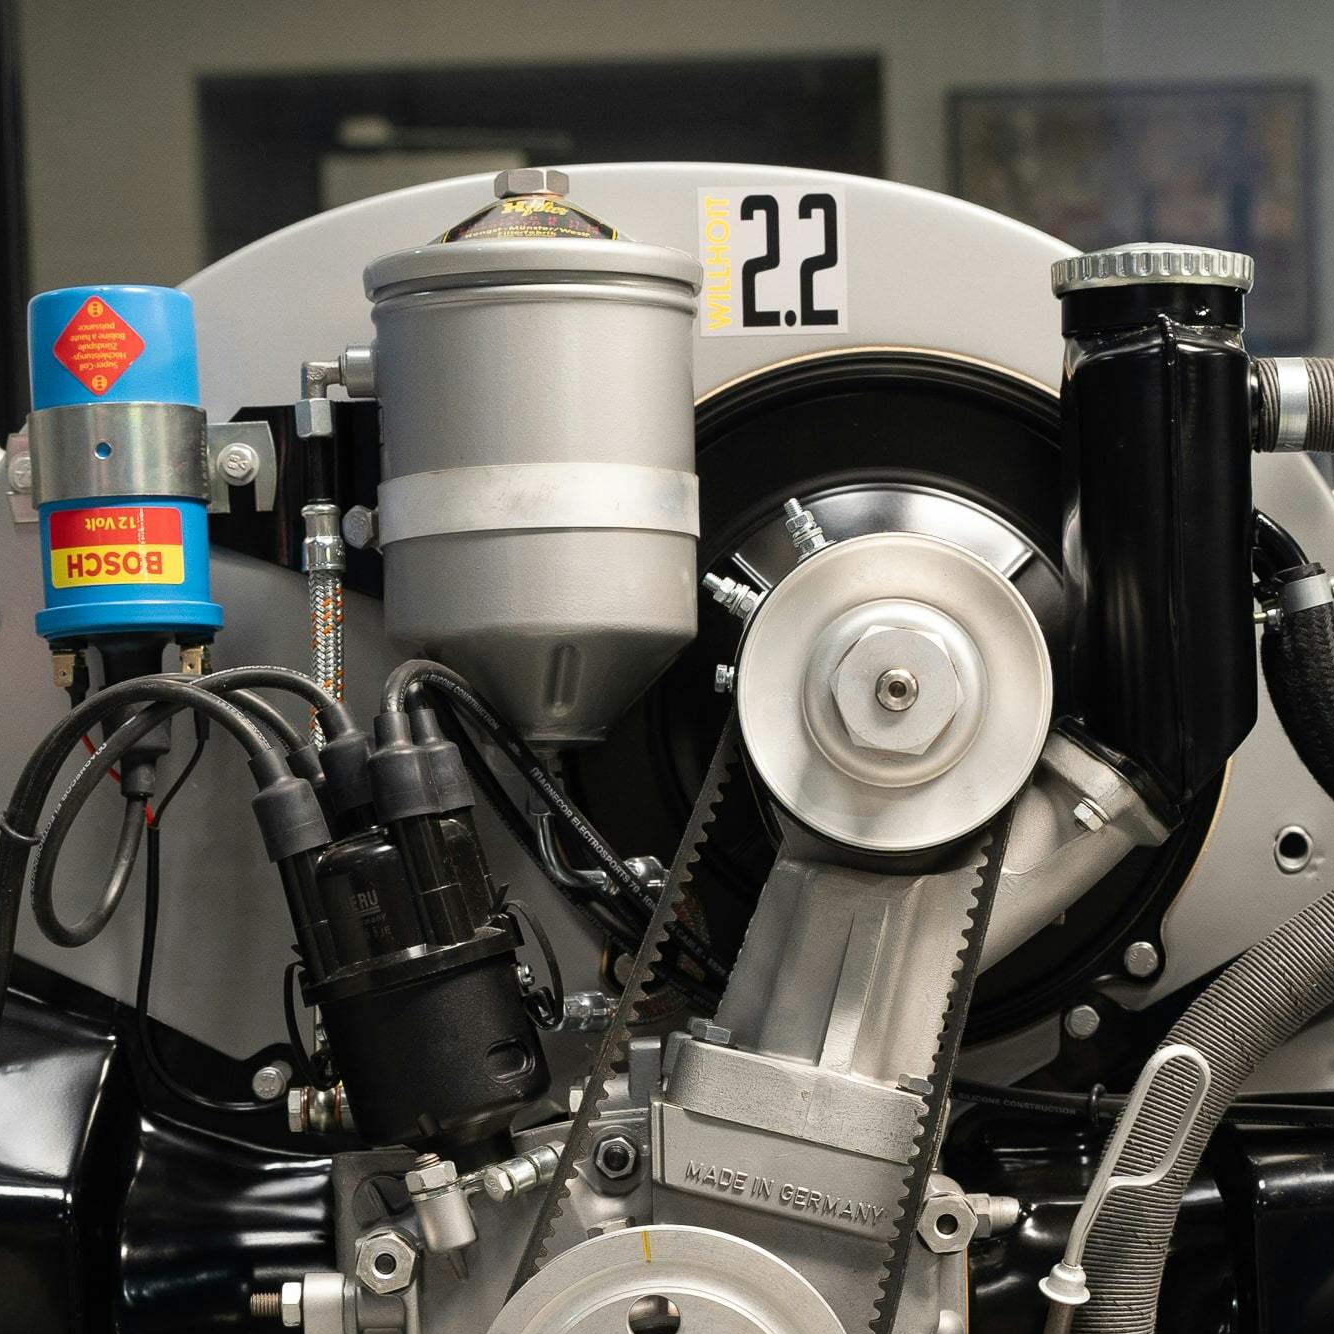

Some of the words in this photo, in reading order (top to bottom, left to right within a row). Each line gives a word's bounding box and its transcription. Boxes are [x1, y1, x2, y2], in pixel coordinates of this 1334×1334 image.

[740, 193, 838, 327] 2.2
[84, 516, 116, 531] Volt
[117, 516, 137, 529] 12
[66, 551, 163, 579] BOSCH
[572, 815, 631, 885] ELECTROSPORTS
[685, 1160, 748, 1191] MADE
[750, 1176, 775, 1197] IN
[779, 1183, 884, 1226] GERMANY
